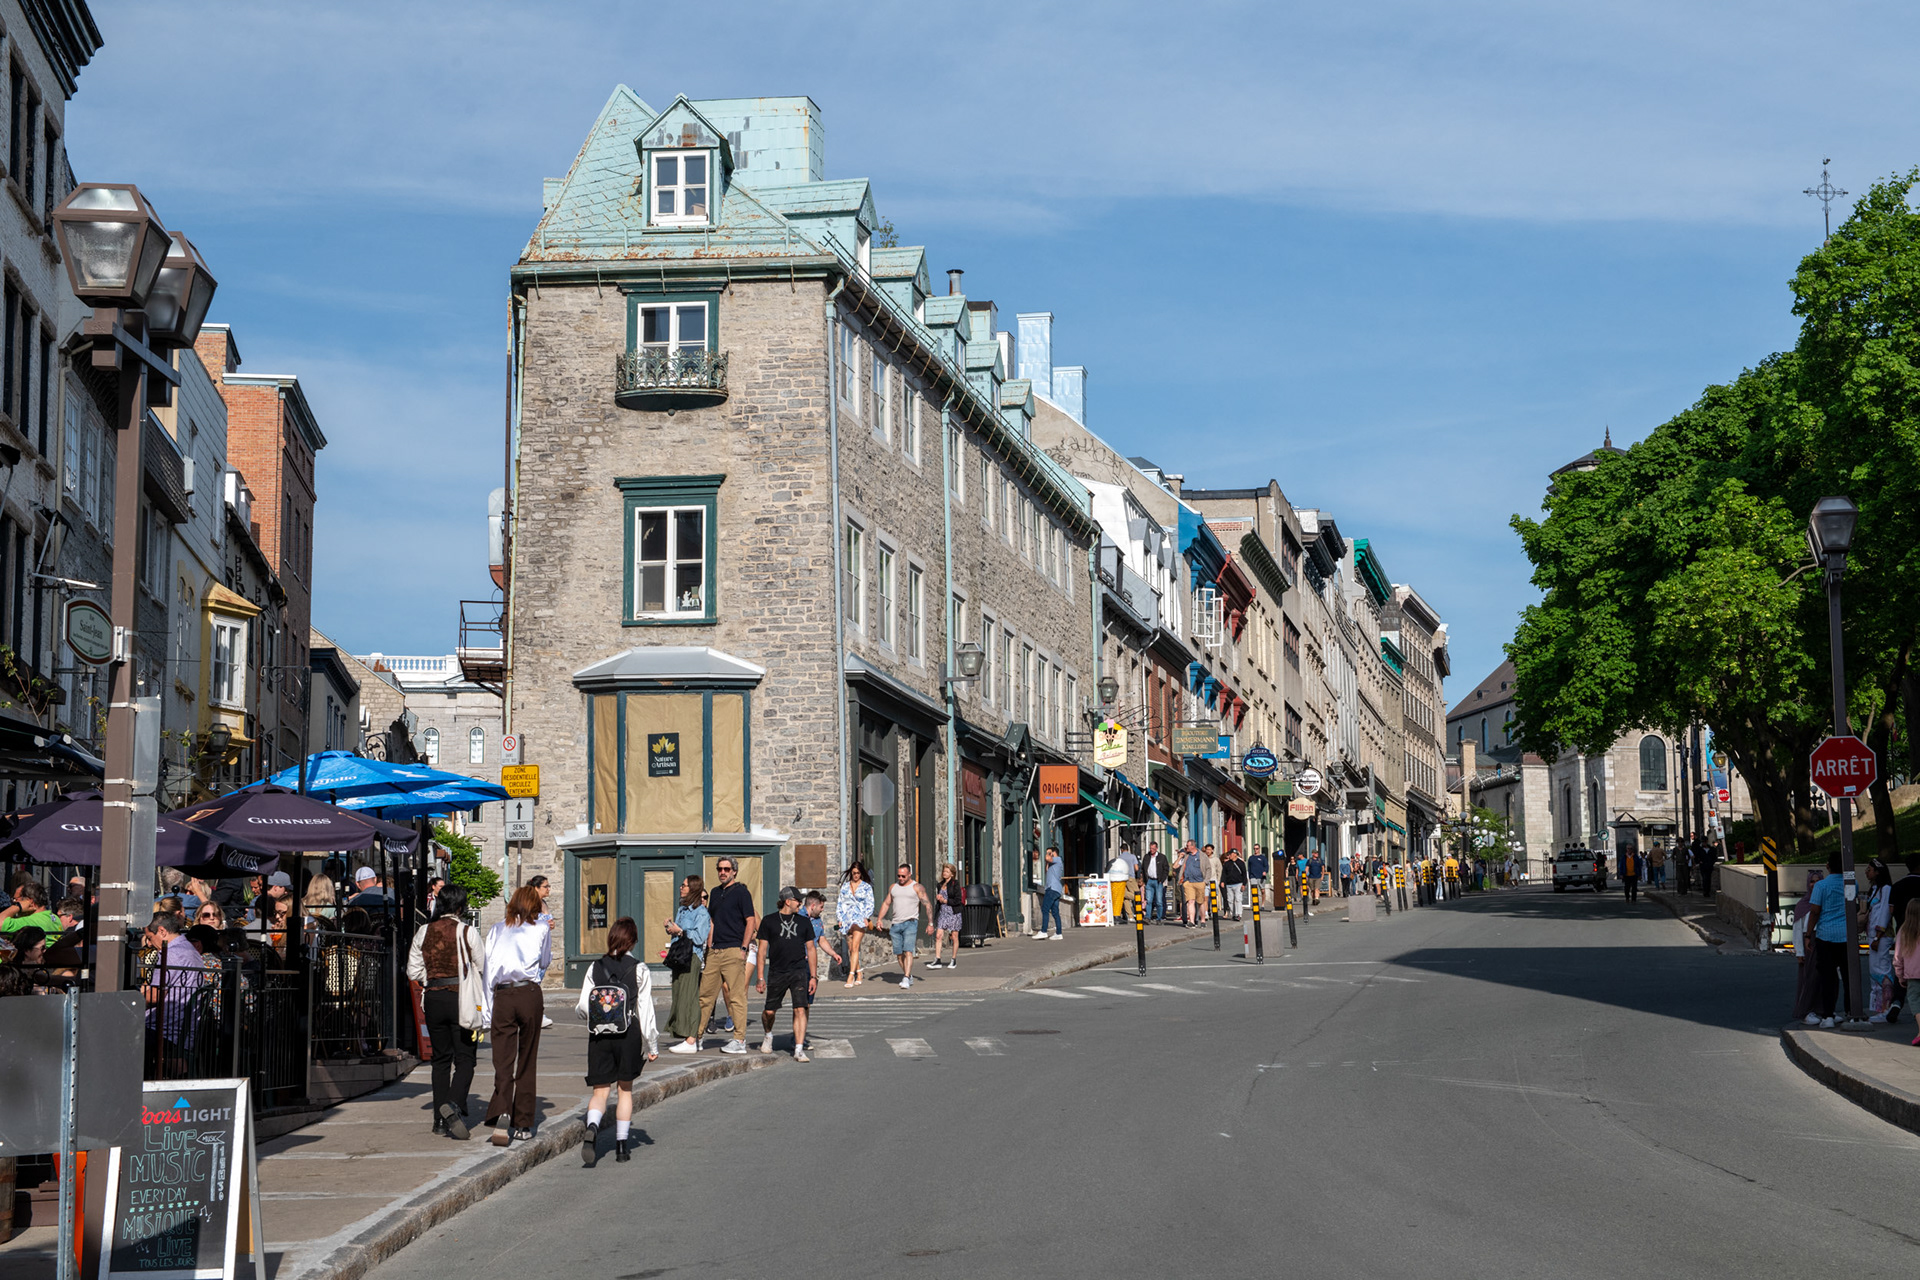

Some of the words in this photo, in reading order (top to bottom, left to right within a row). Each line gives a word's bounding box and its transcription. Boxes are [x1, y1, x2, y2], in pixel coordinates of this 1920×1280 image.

[79, 620, 103, 640] Saint-Jean
[1815, 755, 1872, 777] ARRÊT
[1042, 783, 1075, 794] ORIGINES
[1289, 803, 1314, 811] Fillion
[247, 816, 332, 826] GUINNESS
[512, 823, 526, 831] SENS
[183, 1107, 231, 1123] LIGHT
[131, 1188, 165, 1205] EVERY
[167, 1187, 187, 1202] DAY
[139, 1258, 158, 1268] TOUS
[159, 1258, 174, 1267] LES
[175, 1257, 196, 1267] JOURS
